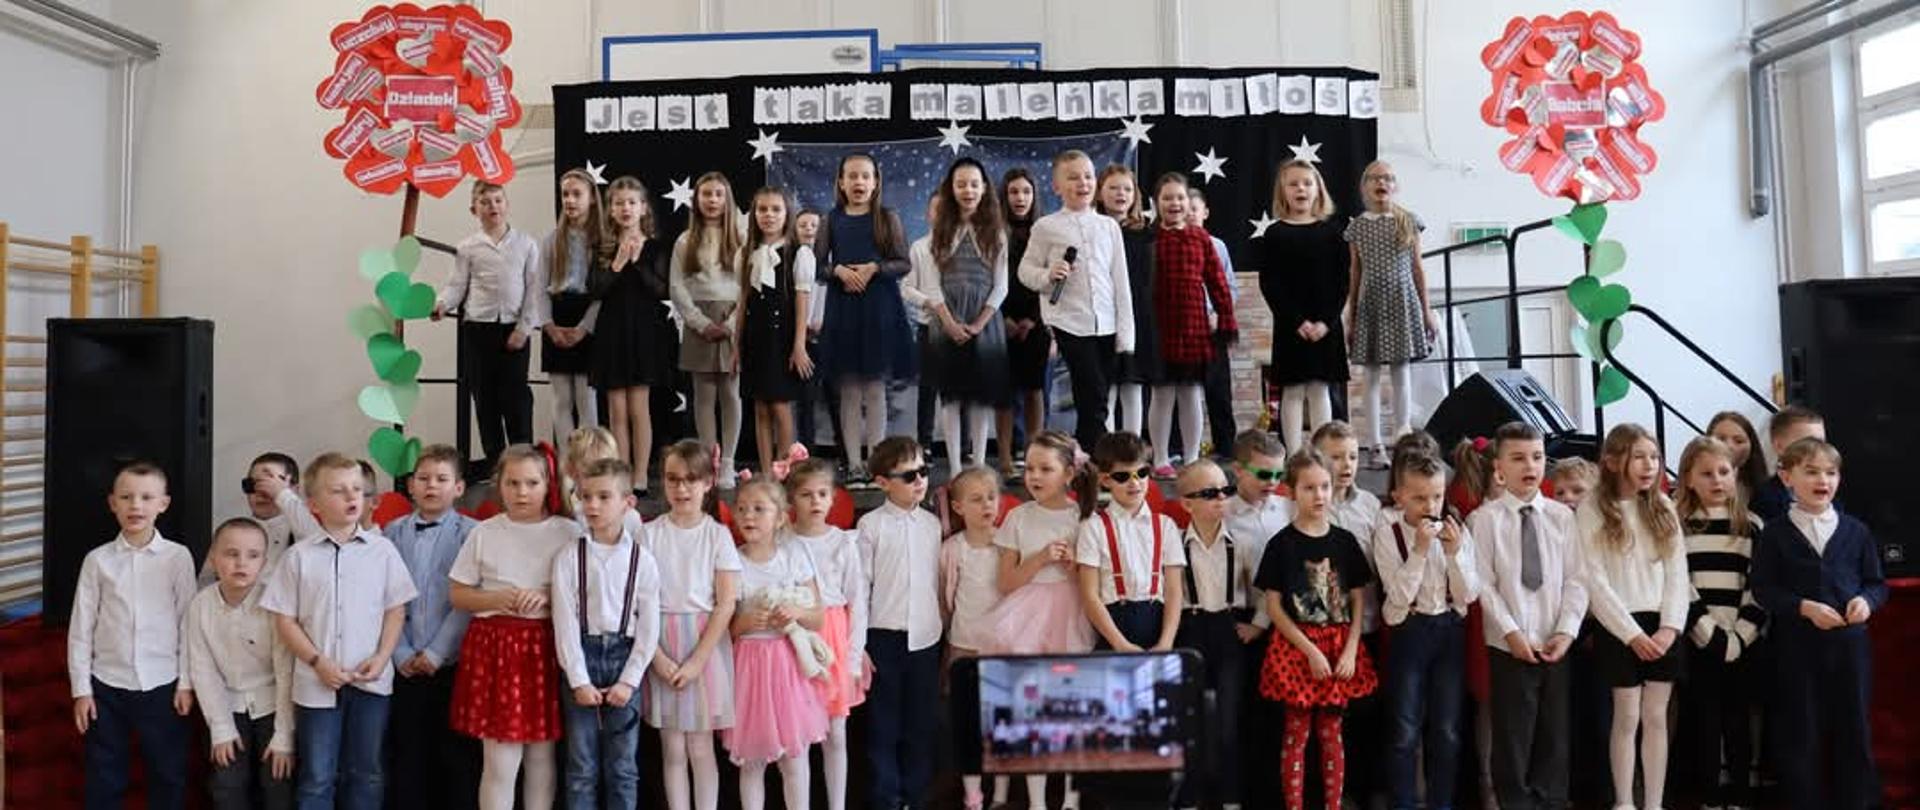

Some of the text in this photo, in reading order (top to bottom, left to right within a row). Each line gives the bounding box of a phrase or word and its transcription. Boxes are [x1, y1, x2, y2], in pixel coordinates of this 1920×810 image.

[388, 91, 455, 105] Dziadek
[487, 76, 507, 118] silny
[592, 99, 719, 129] Jest
[764, 91, 884, 120] taka
[913, 87, 1158, 115] maleńka
